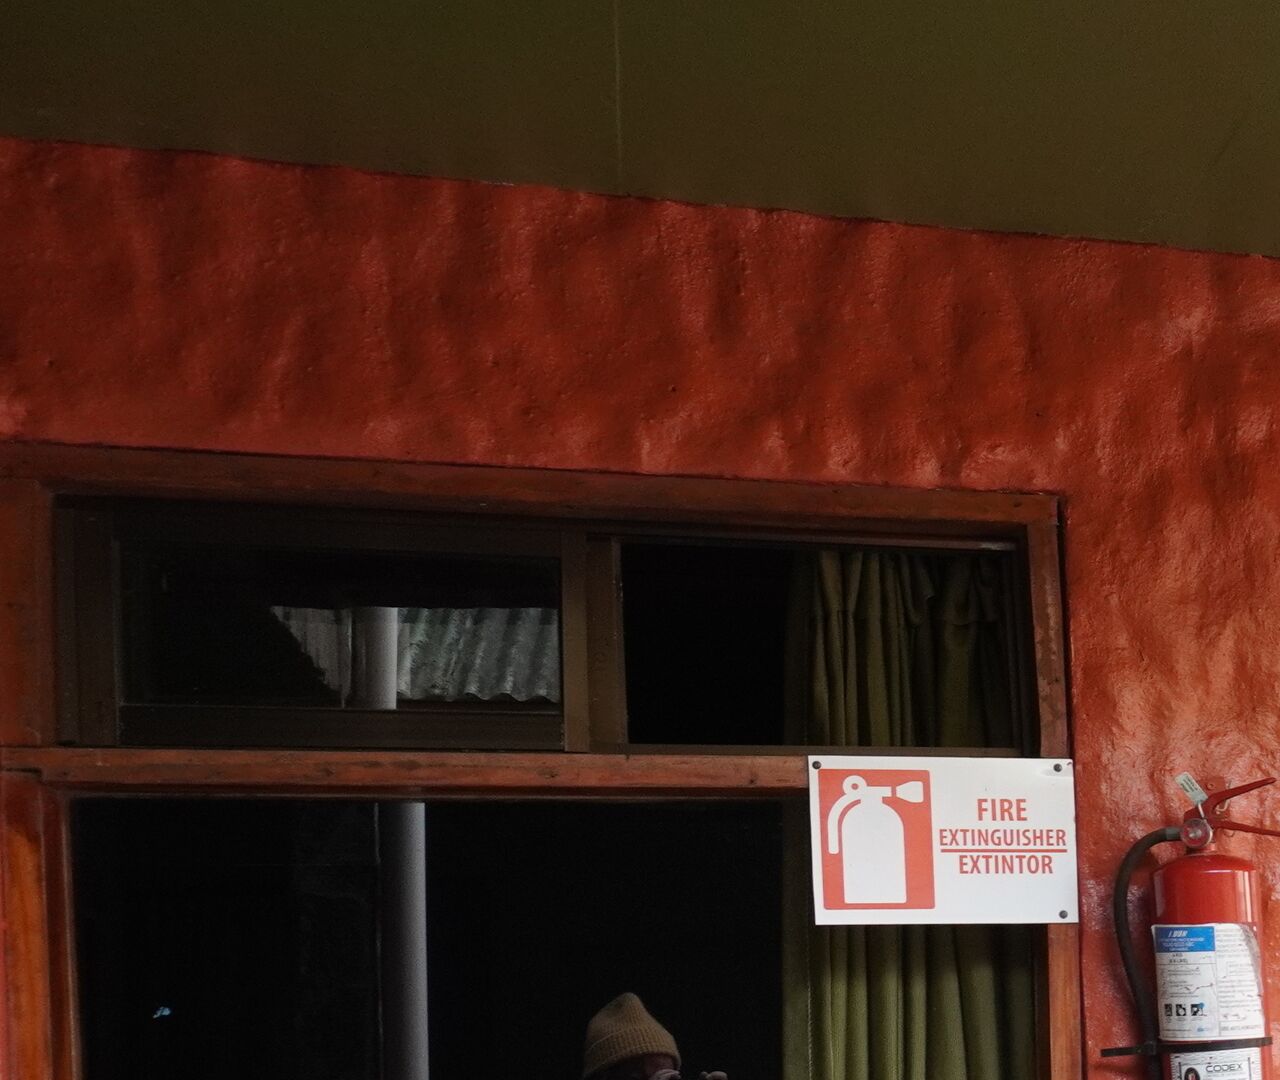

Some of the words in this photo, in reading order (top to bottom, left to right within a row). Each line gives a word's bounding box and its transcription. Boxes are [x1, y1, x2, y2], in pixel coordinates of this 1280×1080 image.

[976, 798, 1028, 822] FIRE
[938, 828, 1067, 847] EXTINGUISHER
[958, 854, 1054, 875] EXTINTOR
[1205, 1063, 1243, 1073] CODEX
